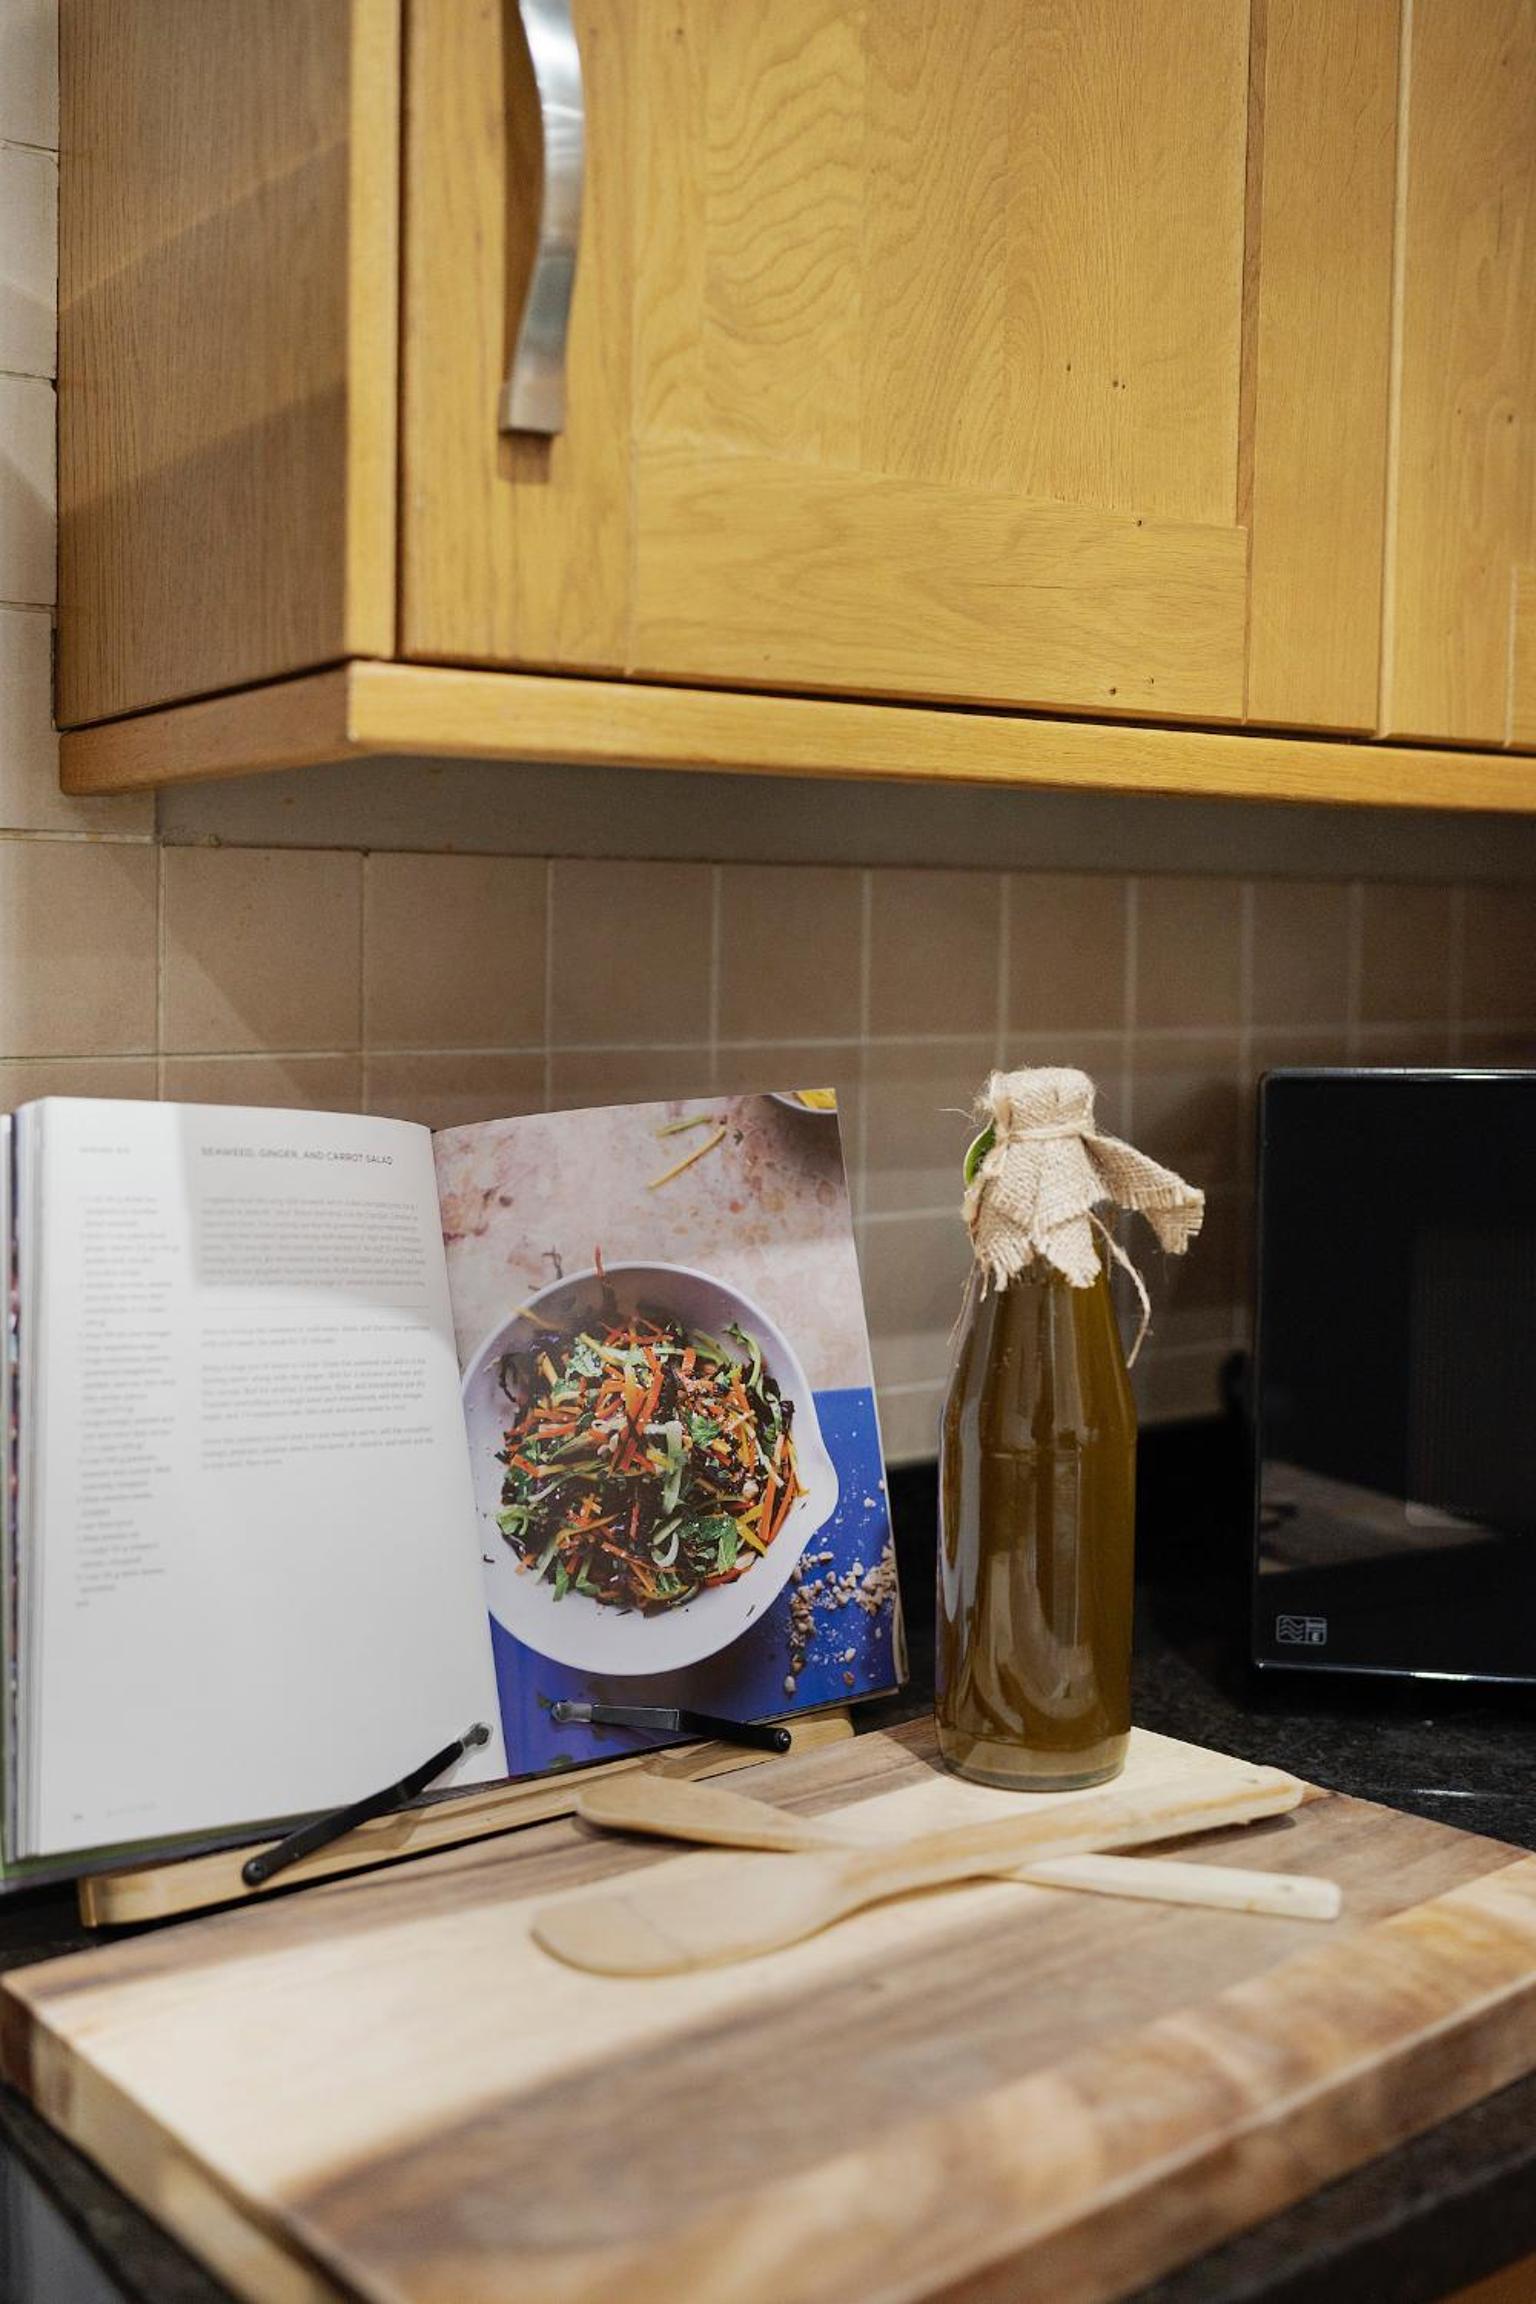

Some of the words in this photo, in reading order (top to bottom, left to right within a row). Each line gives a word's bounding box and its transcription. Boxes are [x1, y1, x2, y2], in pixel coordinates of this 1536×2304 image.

[303, 1150, 324, 1160] AND
[327, 1152, 363, 1163] CARROT
[365, 1154, 394, 1166] SALAD
